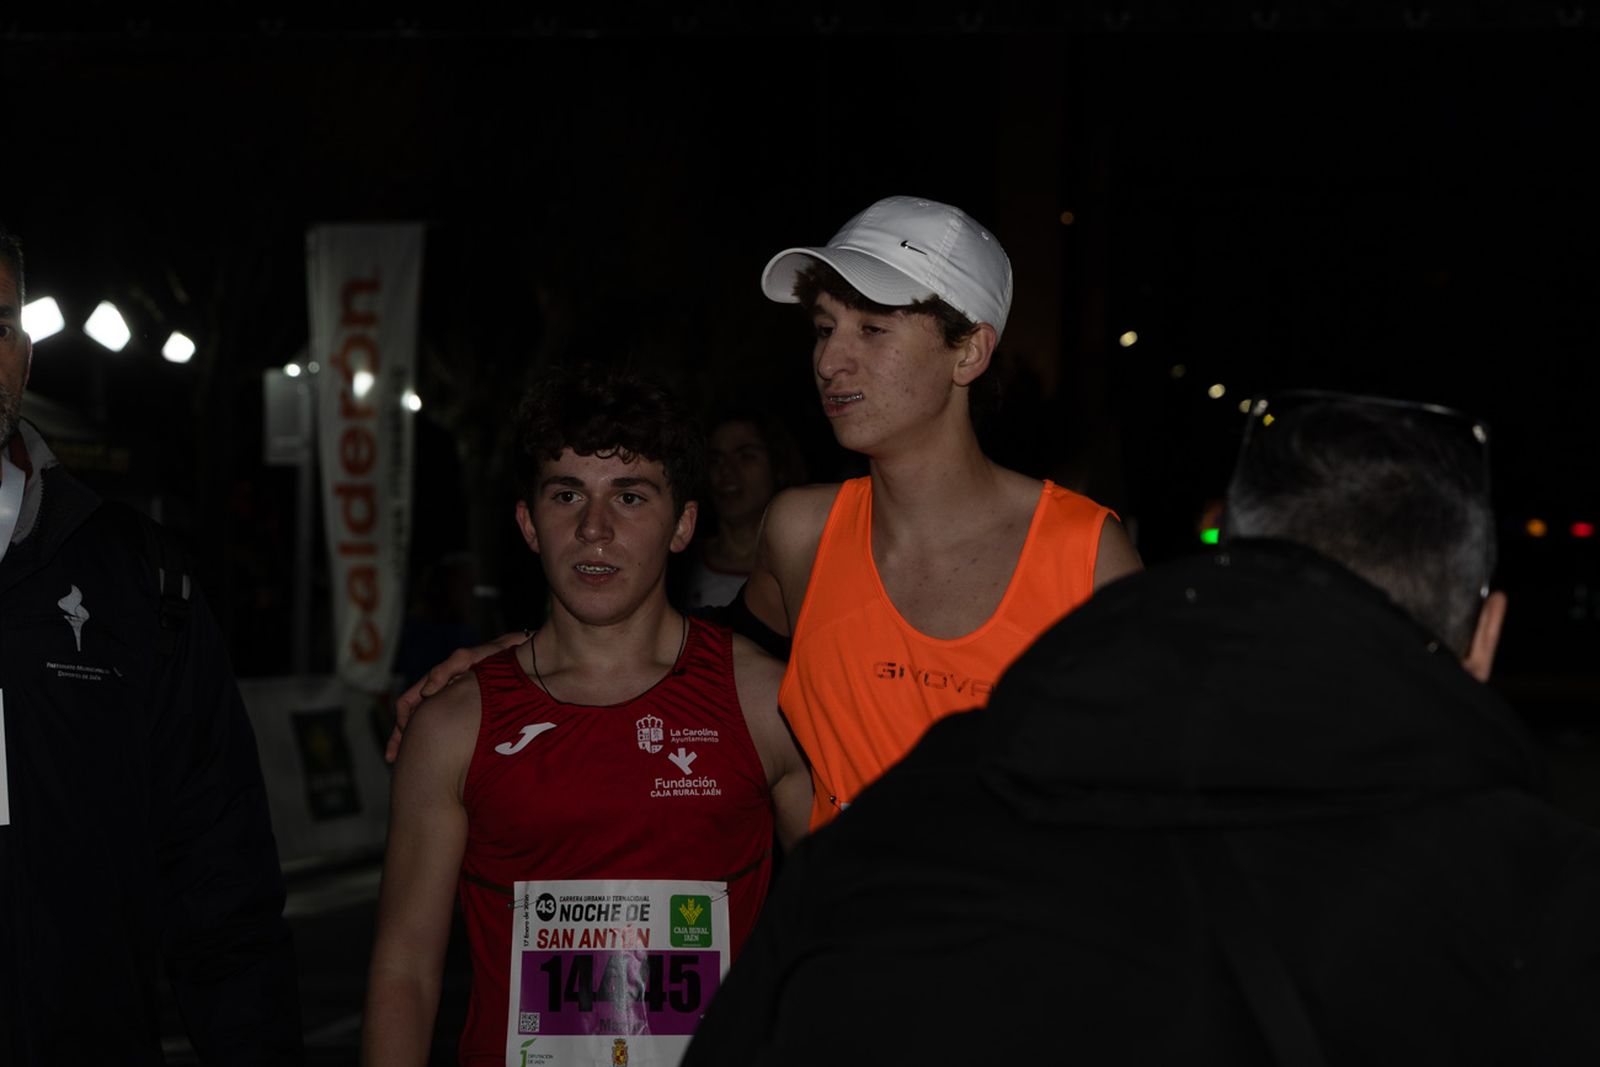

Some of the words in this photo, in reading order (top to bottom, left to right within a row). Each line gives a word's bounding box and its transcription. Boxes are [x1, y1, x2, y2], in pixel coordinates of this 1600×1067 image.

[331, 270, 383, 662] calderón
[670, 728, 681, 737] La
[682, 728, 719, 737] Carolina
[655, 776, 718, 789] Fundación
[650, 790, 672, 798] CAJA
[672, 788, 700, 797] RURAL
[536, 899, 556, 914] 43
[560, 904, 622, 922] NOCHE
[626, 904, 651, 922] DE
[537, 928, 575, 949] SAN
